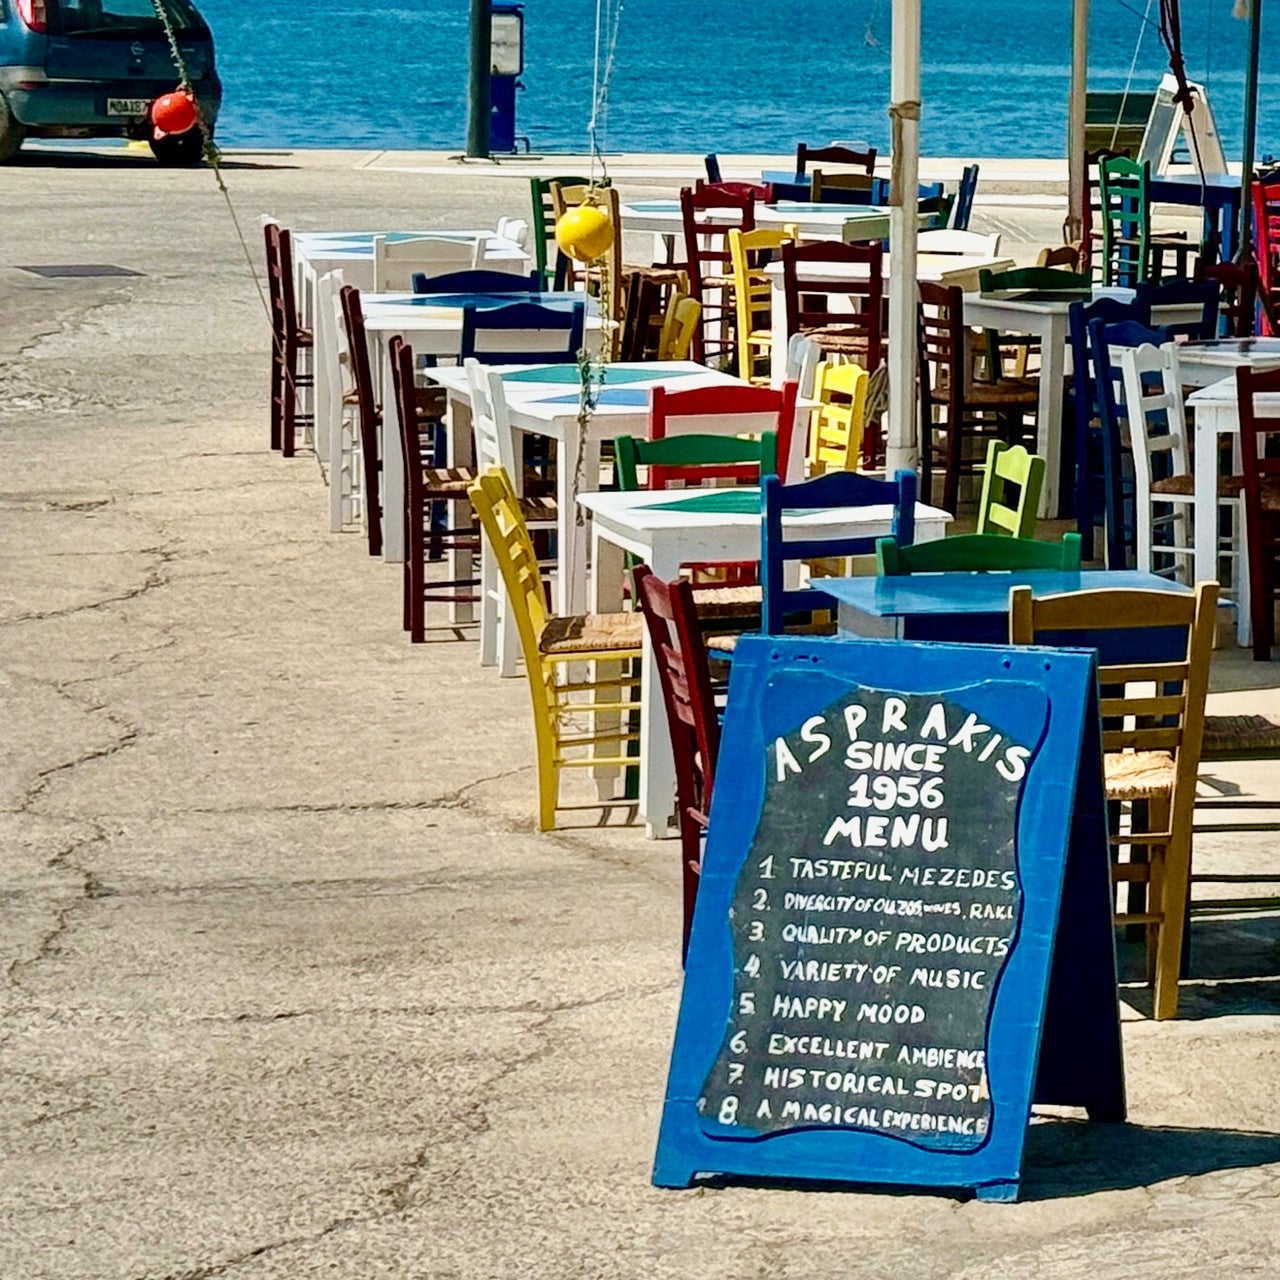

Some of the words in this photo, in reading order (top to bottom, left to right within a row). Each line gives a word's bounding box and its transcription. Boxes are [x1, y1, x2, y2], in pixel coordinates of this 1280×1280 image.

[775, 697, 1032, 782] ASPRAKIS
[844, 741, 948, 772] SINCE
[847, 774, 945, 810] 1956
[823, 814, 949, 852] MENU
[789, 857, 893, 882] TASTEFUL
[900, 866, 1016, 890] MEZEDES
[782, 923, 862, 945] QUALITY
[864, 929, 892, 946] OF
[896, 932, 1010, 957] PRODUCTS
[780, 960, 868, 983] VARIETY
[872, 966, 902, 984] OF
[909, 967, 986, 989] MUSIC
[772, 994, 847, 1022] HAPPY
[857, 1002, 925, 1024] MOOD
[768, 1033, 890, 1060] EXCELLENT
[897, 1045, 986, 1069] AMBIENCE
[763, 1066, 909, 1096] HISTORICAL
[913, 1078, 982, 1104] SPOT
[756, 1098, 773, 1120] A
[781, 1101, 880, 1128] MAGICAL
[882, 1108, 988, 1136] EXPERIENCE
